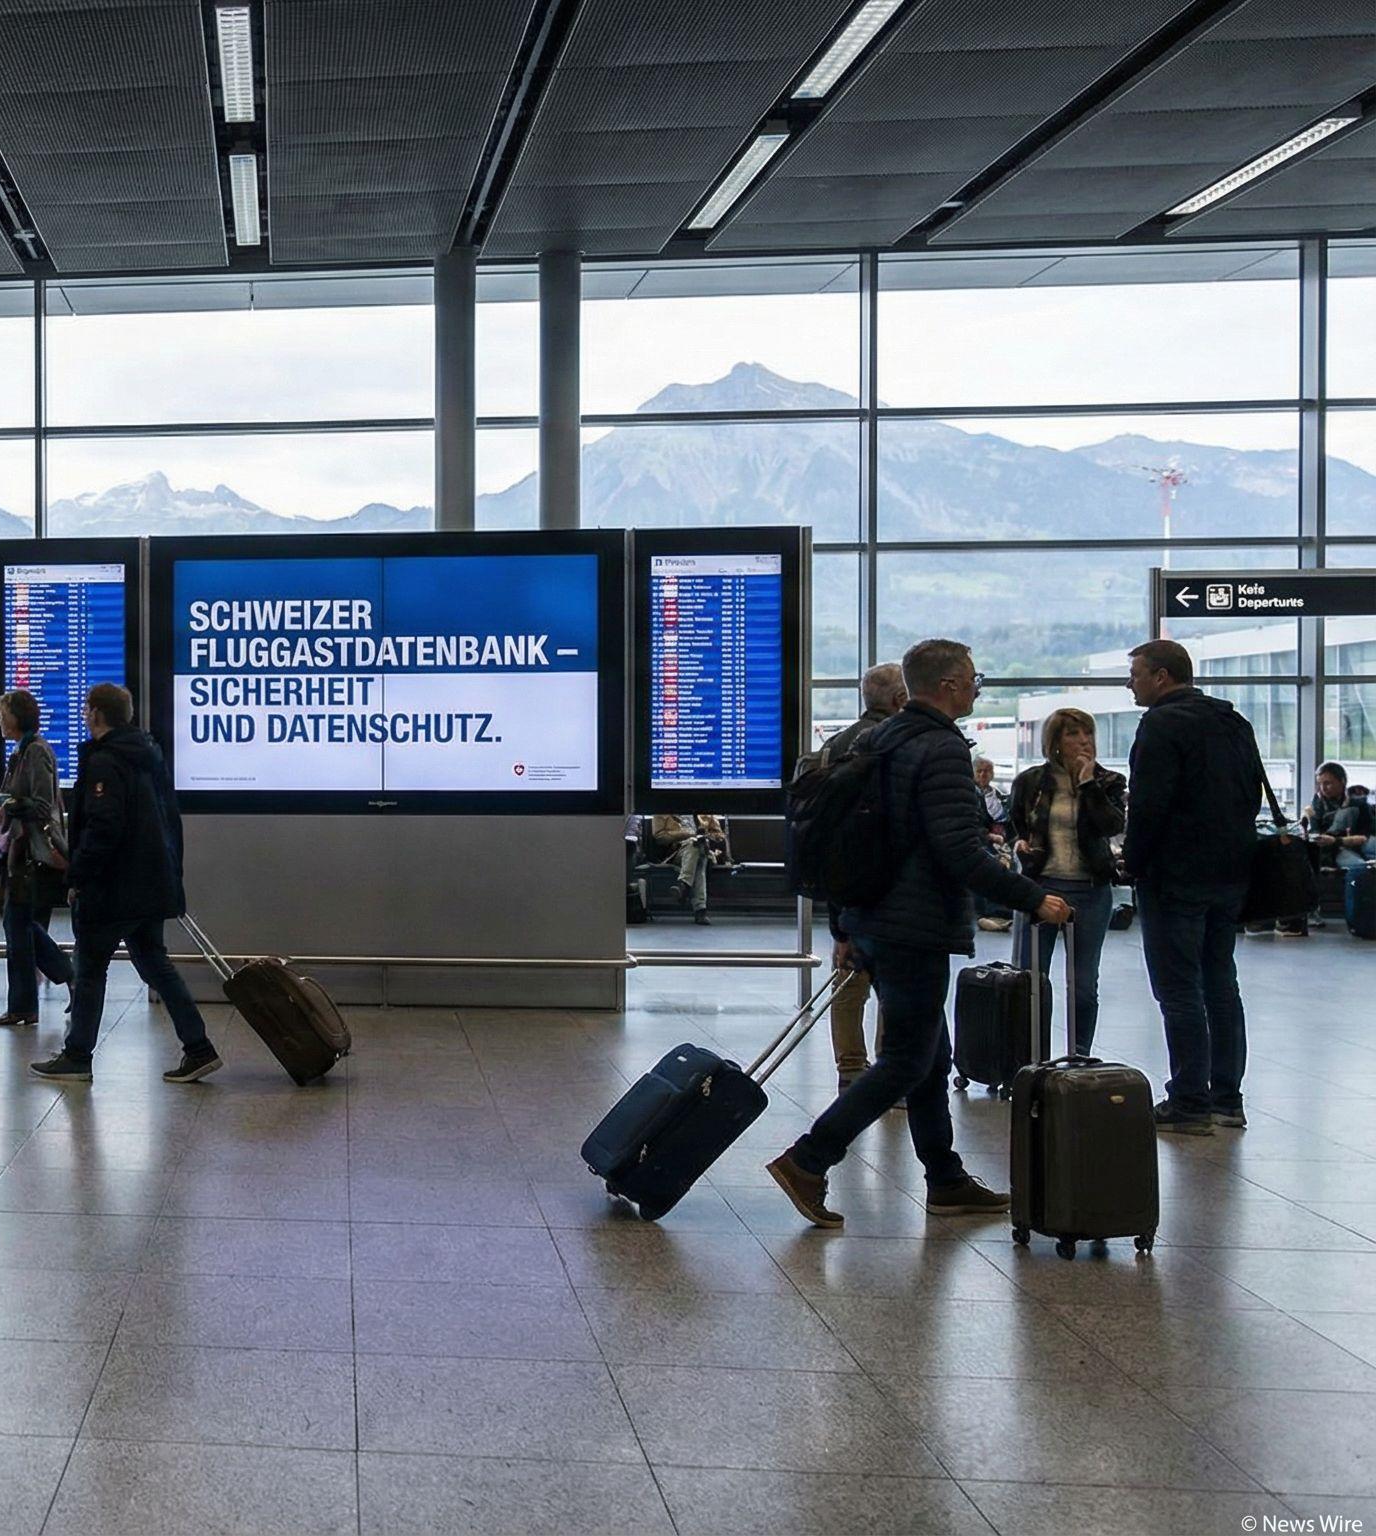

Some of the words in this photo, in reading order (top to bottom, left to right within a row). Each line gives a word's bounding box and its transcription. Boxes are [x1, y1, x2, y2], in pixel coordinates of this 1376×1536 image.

[189, 599, 372, 632] SCHWEIZER
[190, 634, 549, 668] FLUGGASTDATENBANK
[190, 677, 375, 707] SICHERHEIT
[190, 714, 255, 744] UND
[267, 713, 503, 744] DATENSCHUTZ.
